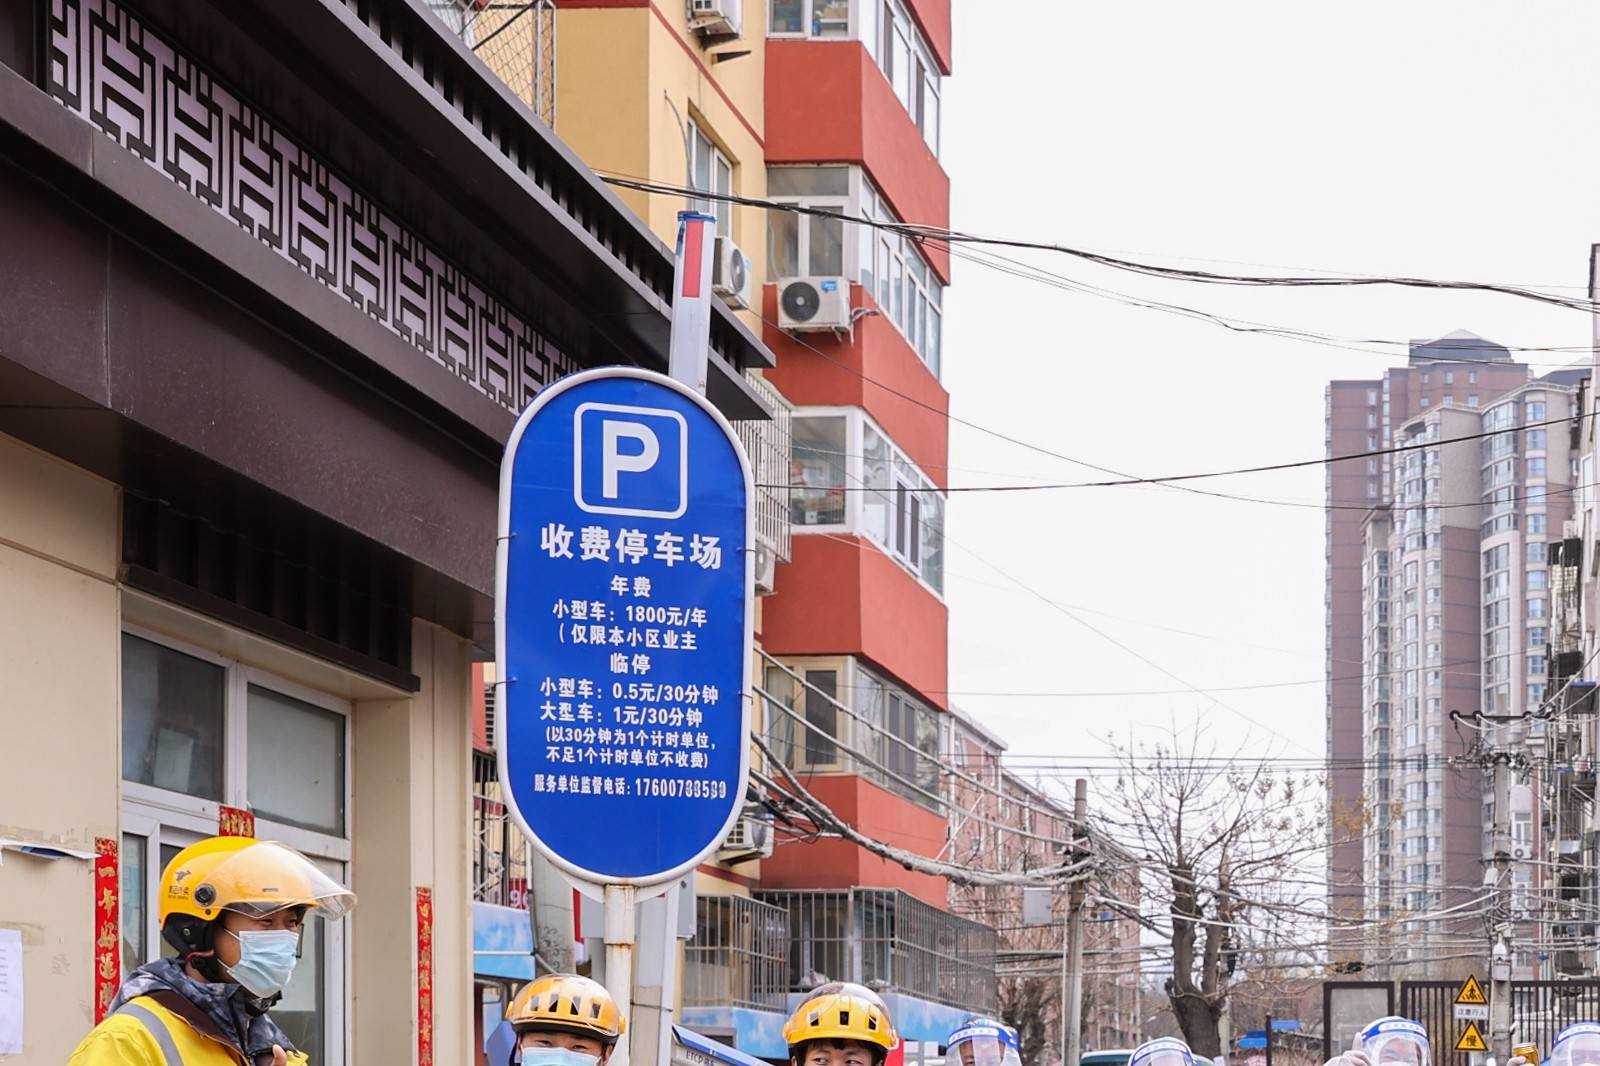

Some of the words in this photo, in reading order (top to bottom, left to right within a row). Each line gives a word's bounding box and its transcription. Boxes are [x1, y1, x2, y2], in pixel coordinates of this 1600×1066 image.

[602, 419, 660, 499] P
[540, 523, 722, 570] 收费停车场
[611, 575, 652, 598] 年费
[610, 652, 651, 675] 临停
